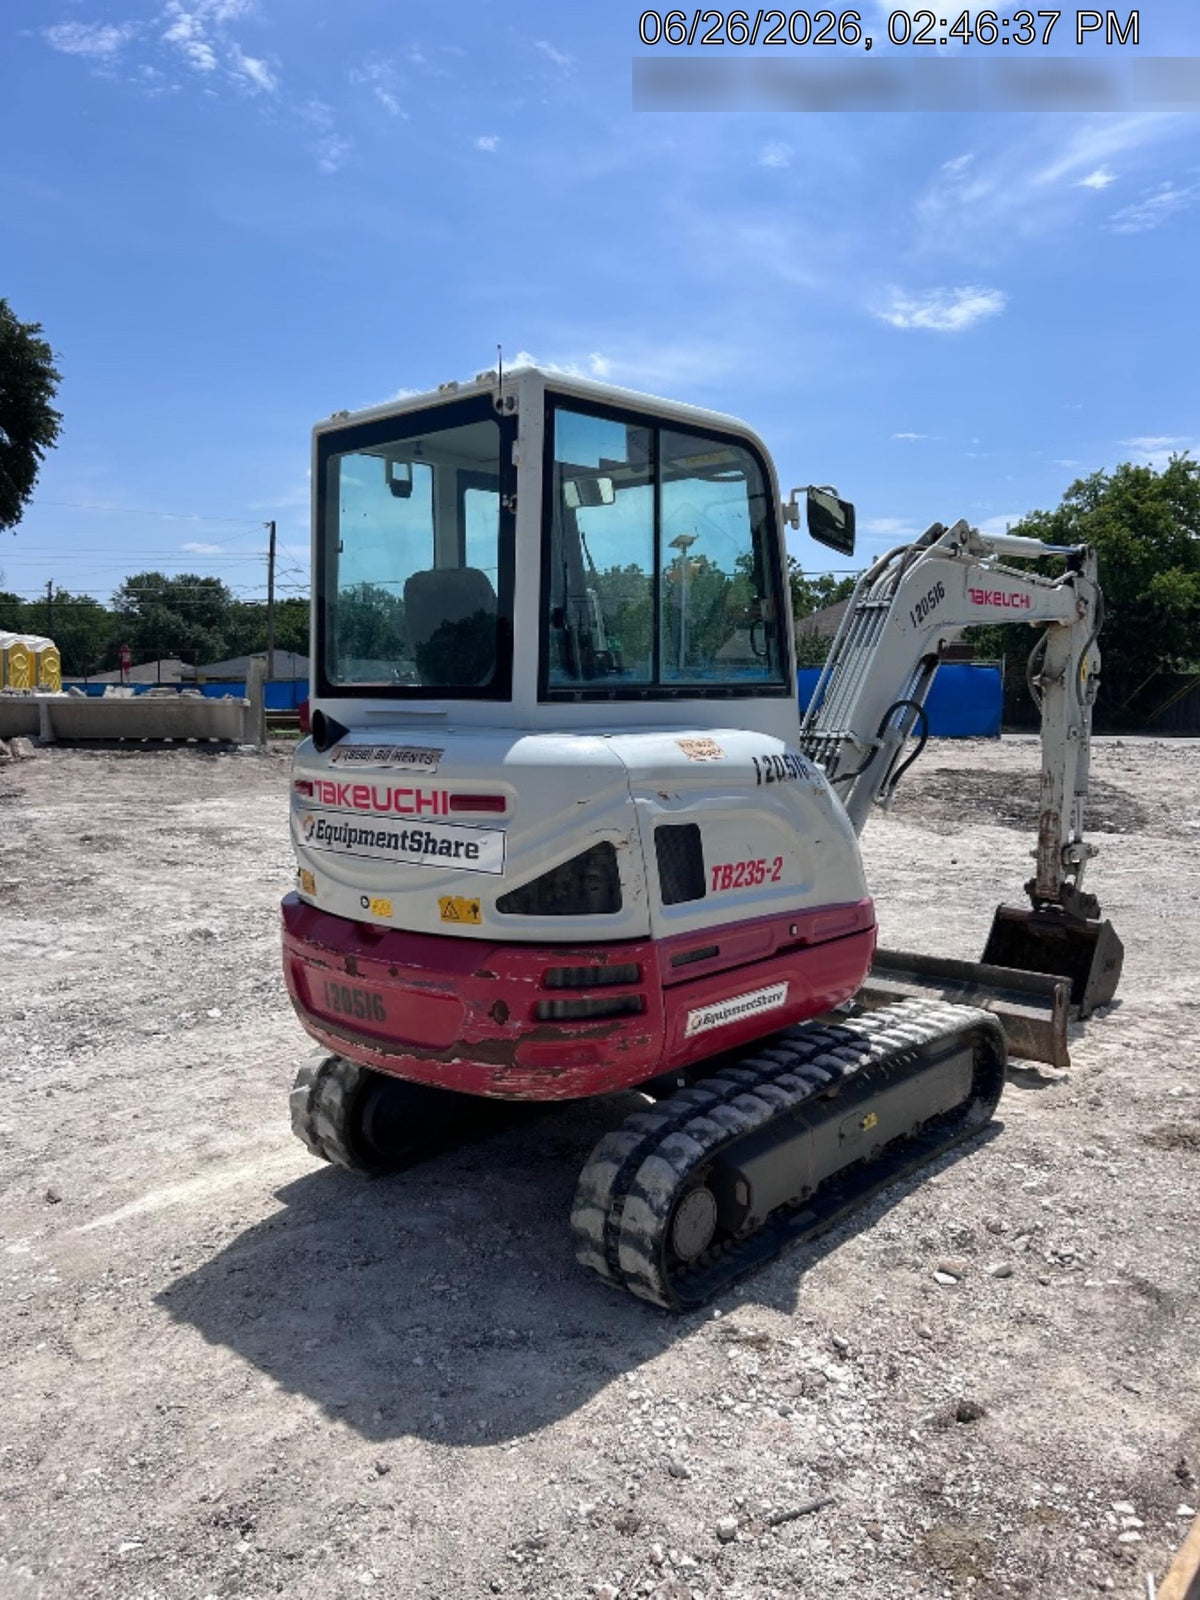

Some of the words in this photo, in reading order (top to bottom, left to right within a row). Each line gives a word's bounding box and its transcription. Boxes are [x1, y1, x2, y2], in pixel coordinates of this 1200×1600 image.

[910, 581, 946, 628] 120516
[968, 588, 1032, 608] TAKEUCHI
[752, 754, 810, 786] 120516
[314, 779, 449, 816] TAKEUCHI
[315, 819, 480, 860] EquipmentShare
[711, 856, 783, 891] TB235-2
[323, 980, 387, 1023] 120516
